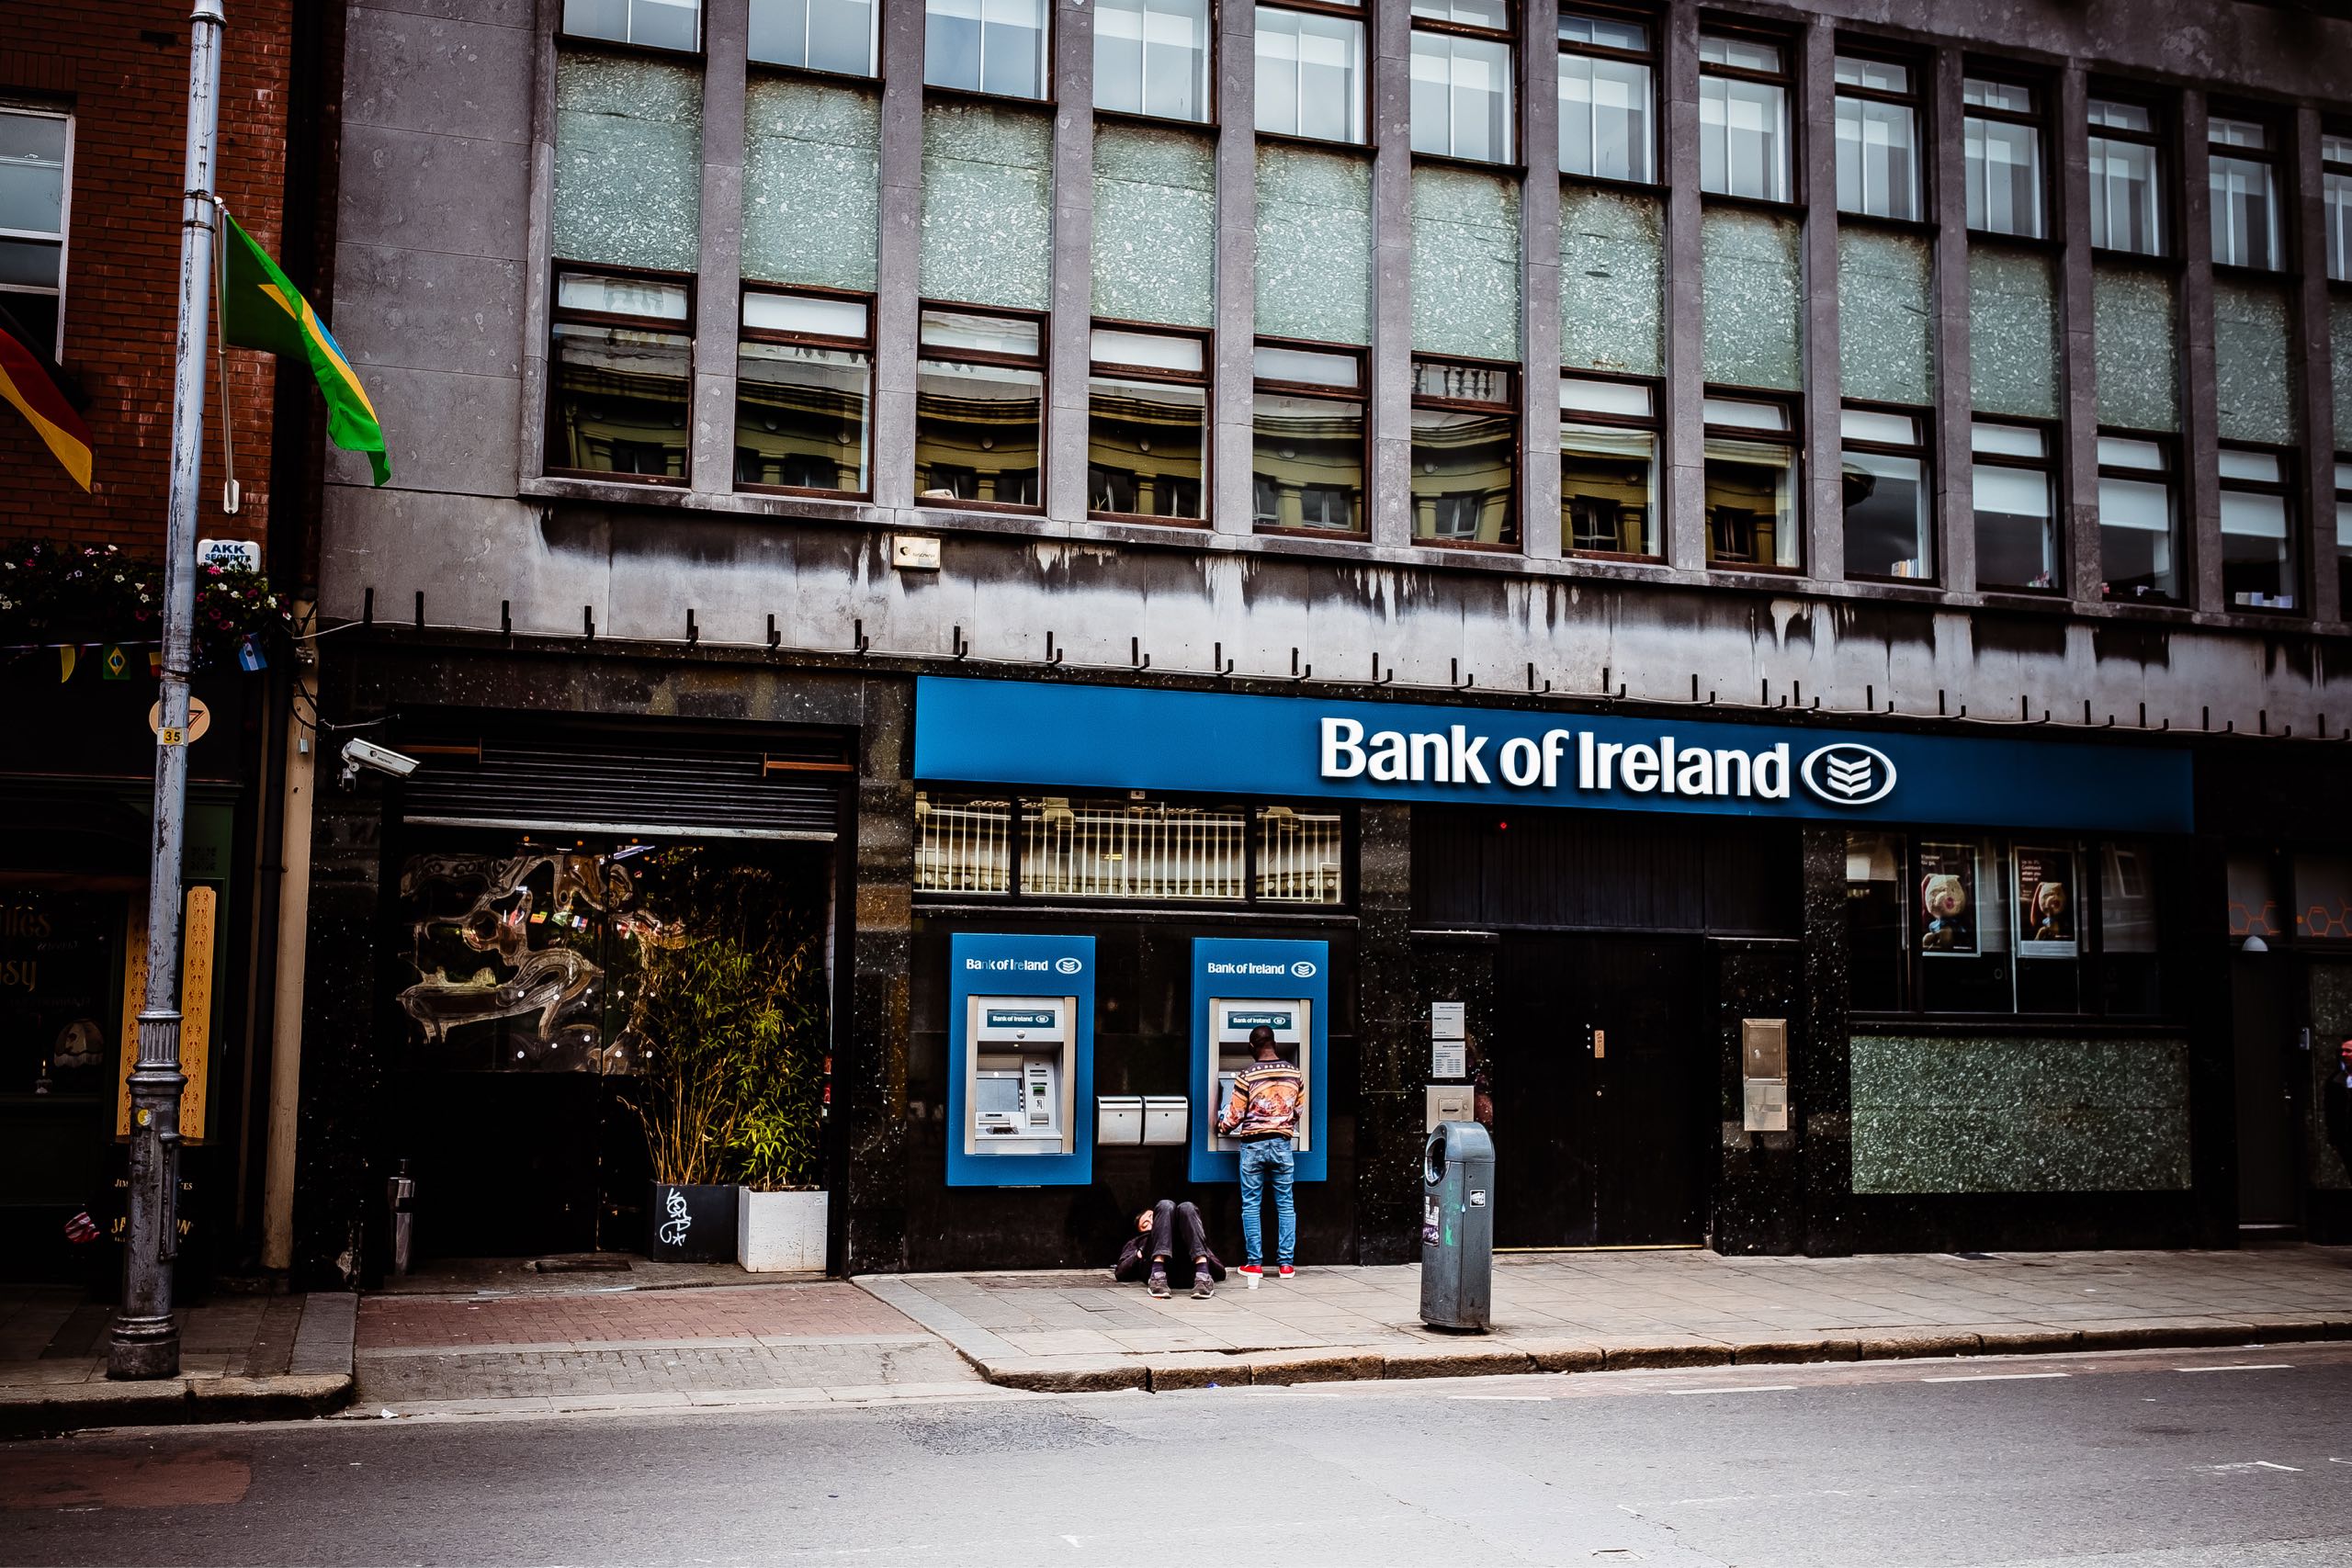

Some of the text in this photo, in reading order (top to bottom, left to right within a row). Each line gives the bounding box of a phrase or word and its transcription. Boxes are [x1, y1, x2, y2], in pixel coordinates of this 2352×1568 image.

[210, 544, 245, 554] AKK
[165, 731, 181, 742] 35
[1320, 716, 1790, 798] Bank of Ireland
[967, 958, 1048, 971] Bank of Ireland
[1207, 963, 1284, 975] Bank of Ireland
[0, 960, 37, 992] sy
